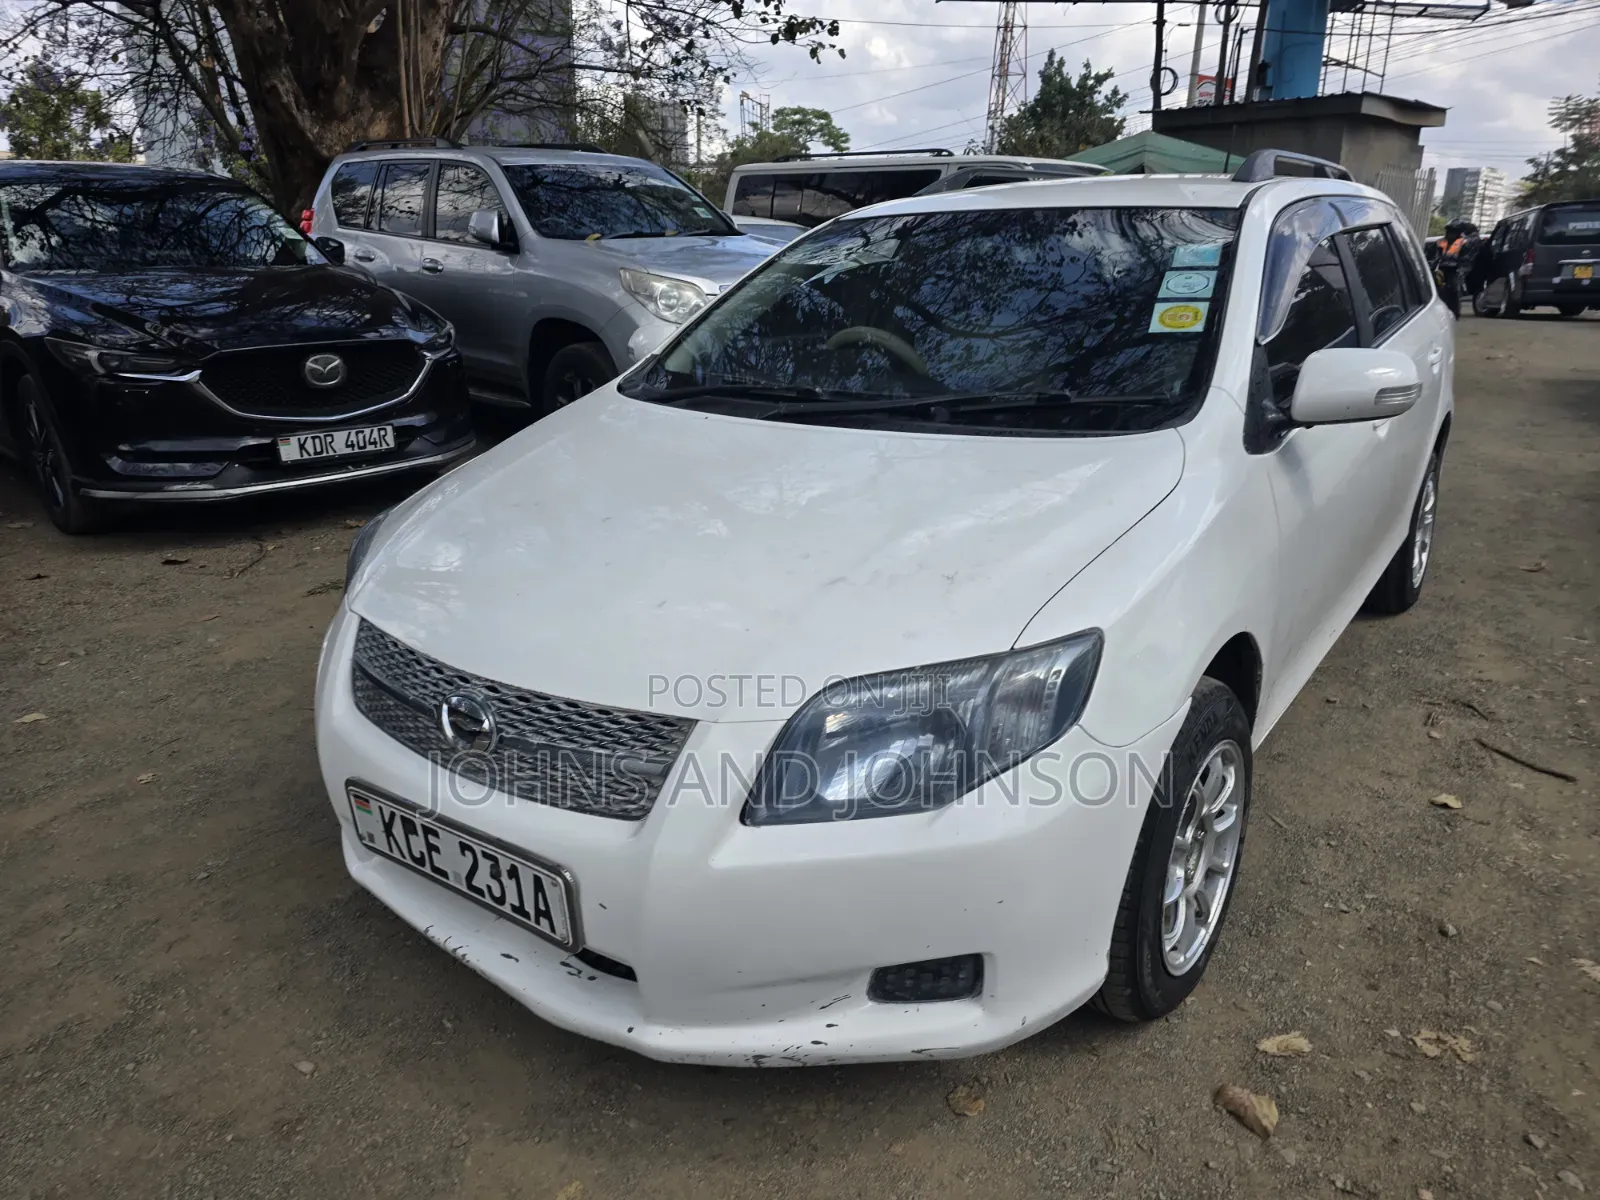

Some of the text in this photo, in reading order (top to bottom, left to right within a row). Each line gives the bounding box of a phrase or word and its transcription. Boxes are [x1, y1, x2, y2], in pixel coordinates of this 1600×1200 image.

[297, 427, 390, 458] KDR 404R
[378, 804, 557, 936] KCE 231A
